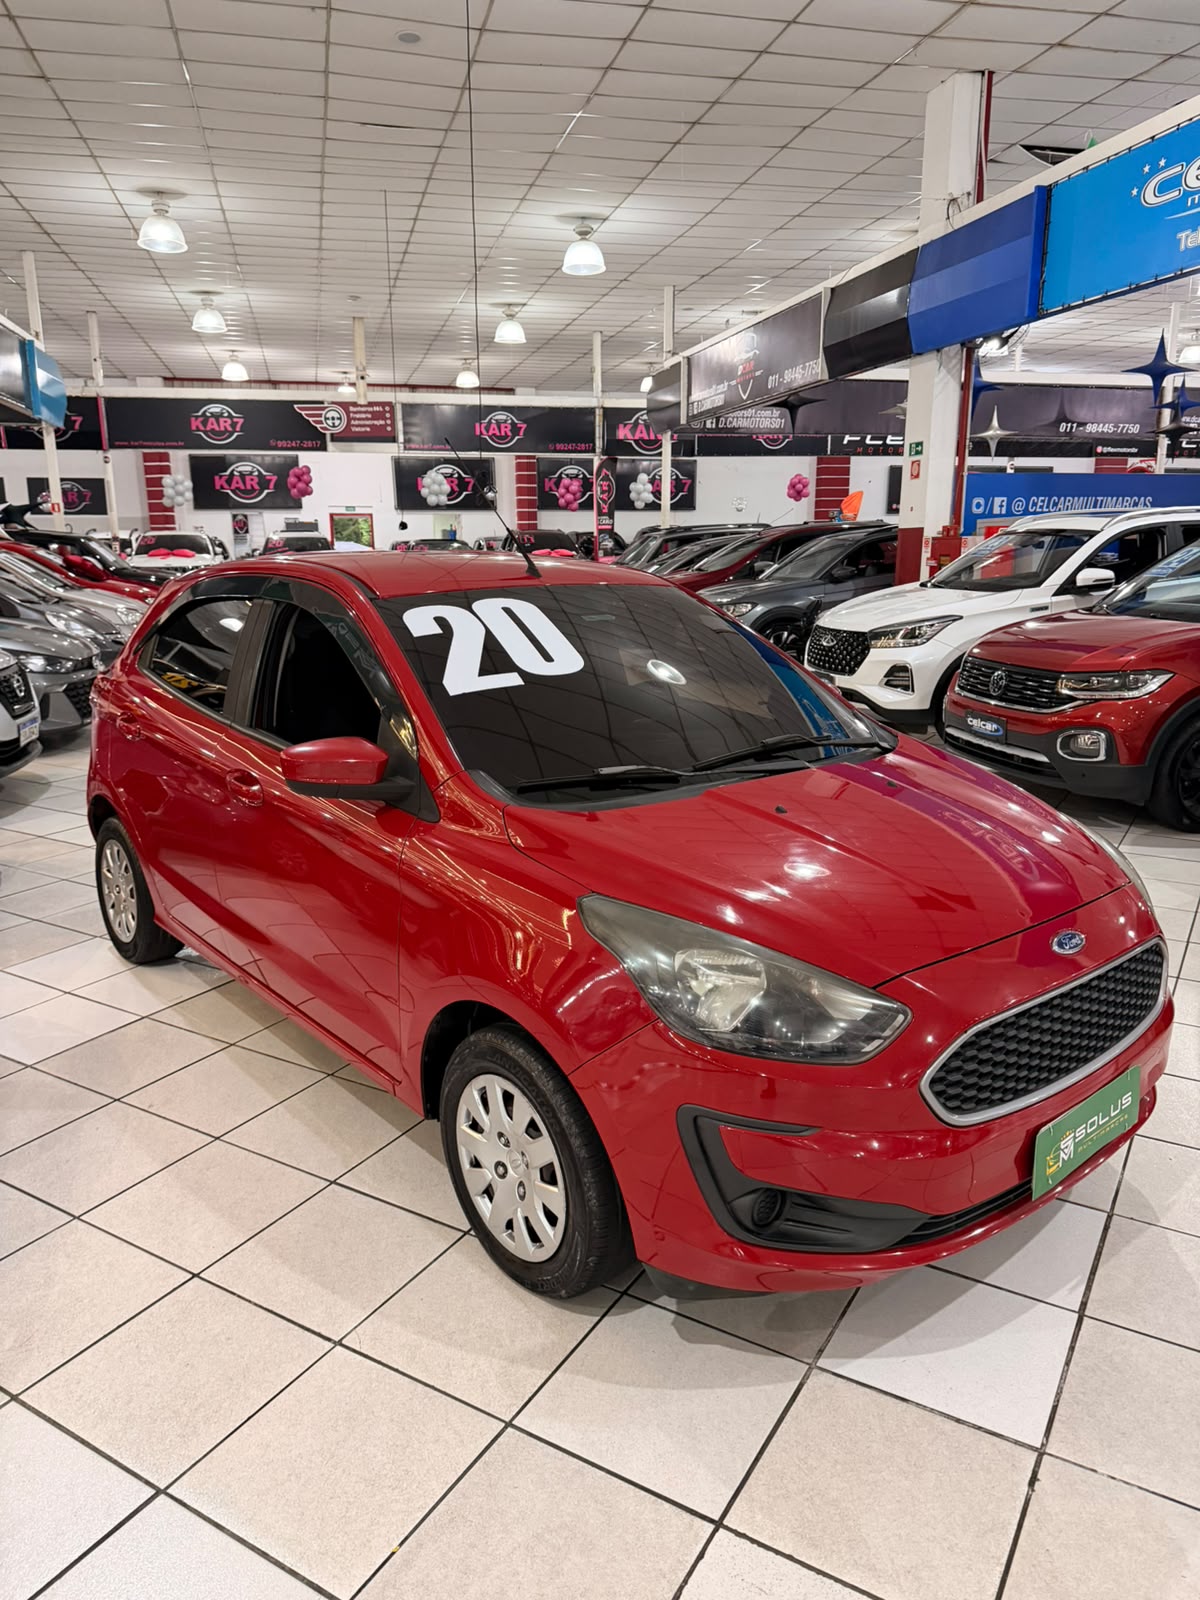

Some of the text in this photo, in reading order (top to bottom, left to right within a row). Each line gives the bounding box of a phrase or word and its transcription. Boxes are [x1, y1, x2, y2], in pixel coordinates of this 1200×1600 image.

[1059, 422, 1078, 433] 011
[1085, 422, 1141, 434] 98445-7750
[213, 475, 278, 490] KAR 7
[1028, 496, 1153, 513] CELCARMULTIMARCAS
[402, 597, 585, 697] 20
[1060, 934, 1082, 949] Ford
[1075, 1091, 1133, 1143] SOLUS
